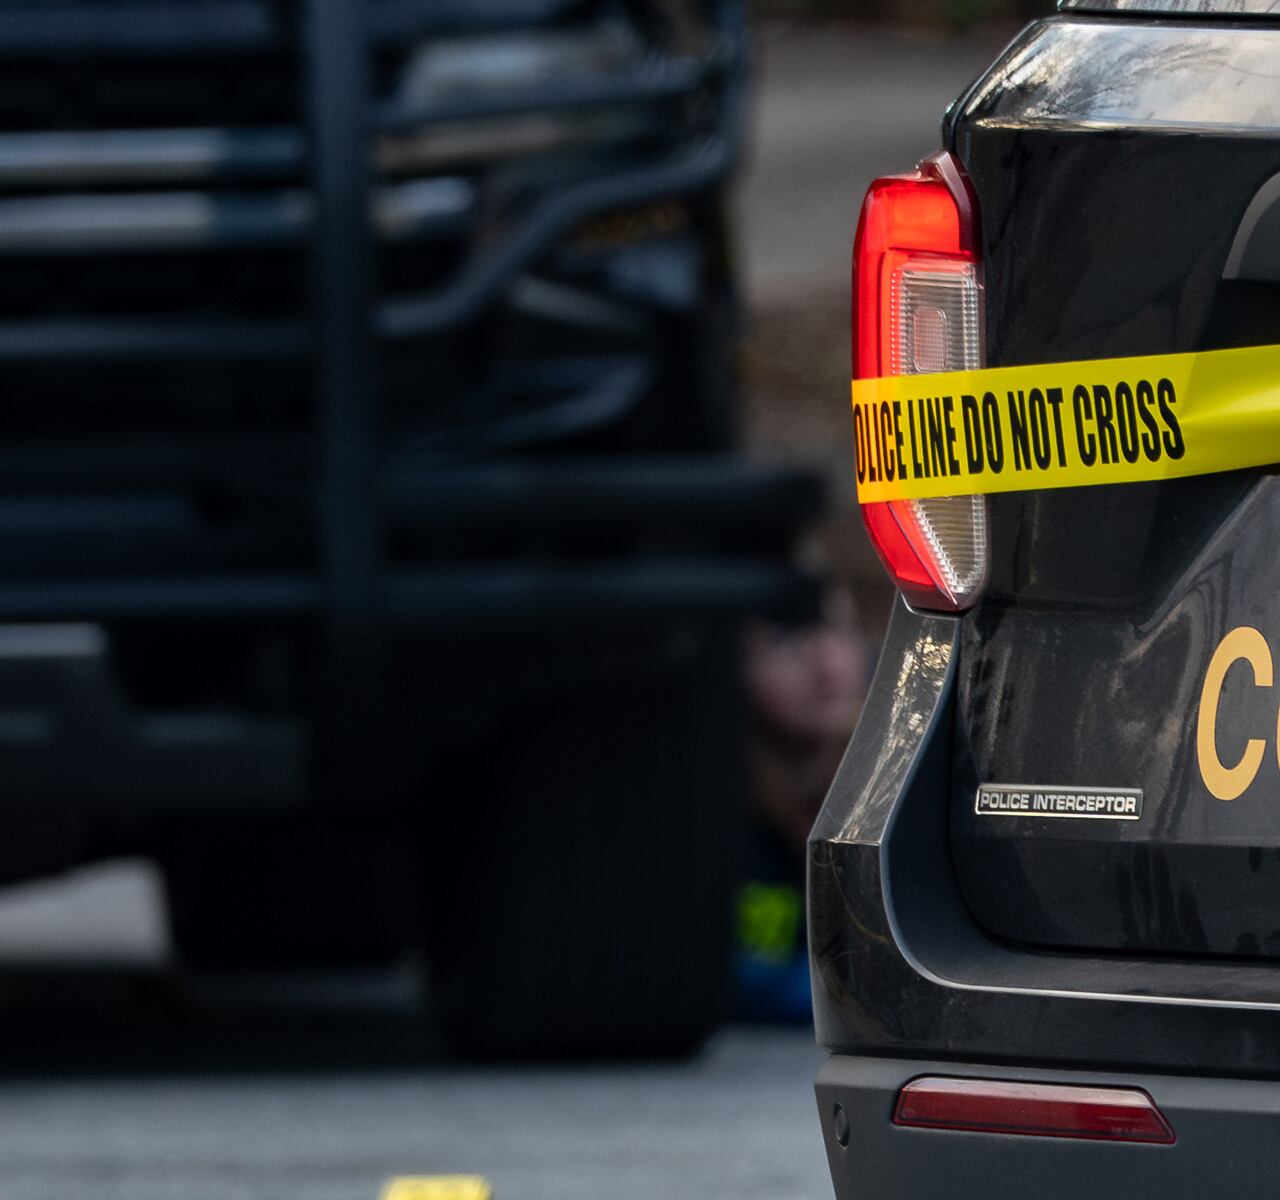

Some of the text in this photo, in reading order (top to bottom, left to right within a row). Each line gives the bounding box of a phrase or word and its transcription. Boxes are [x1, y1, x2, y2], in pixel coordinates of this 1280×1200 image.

[854, 378, 1186, 485] OLICE LINE DO NOT CROSS
[980, 792, 1137, 813] POLICE INTERCEPTOR
